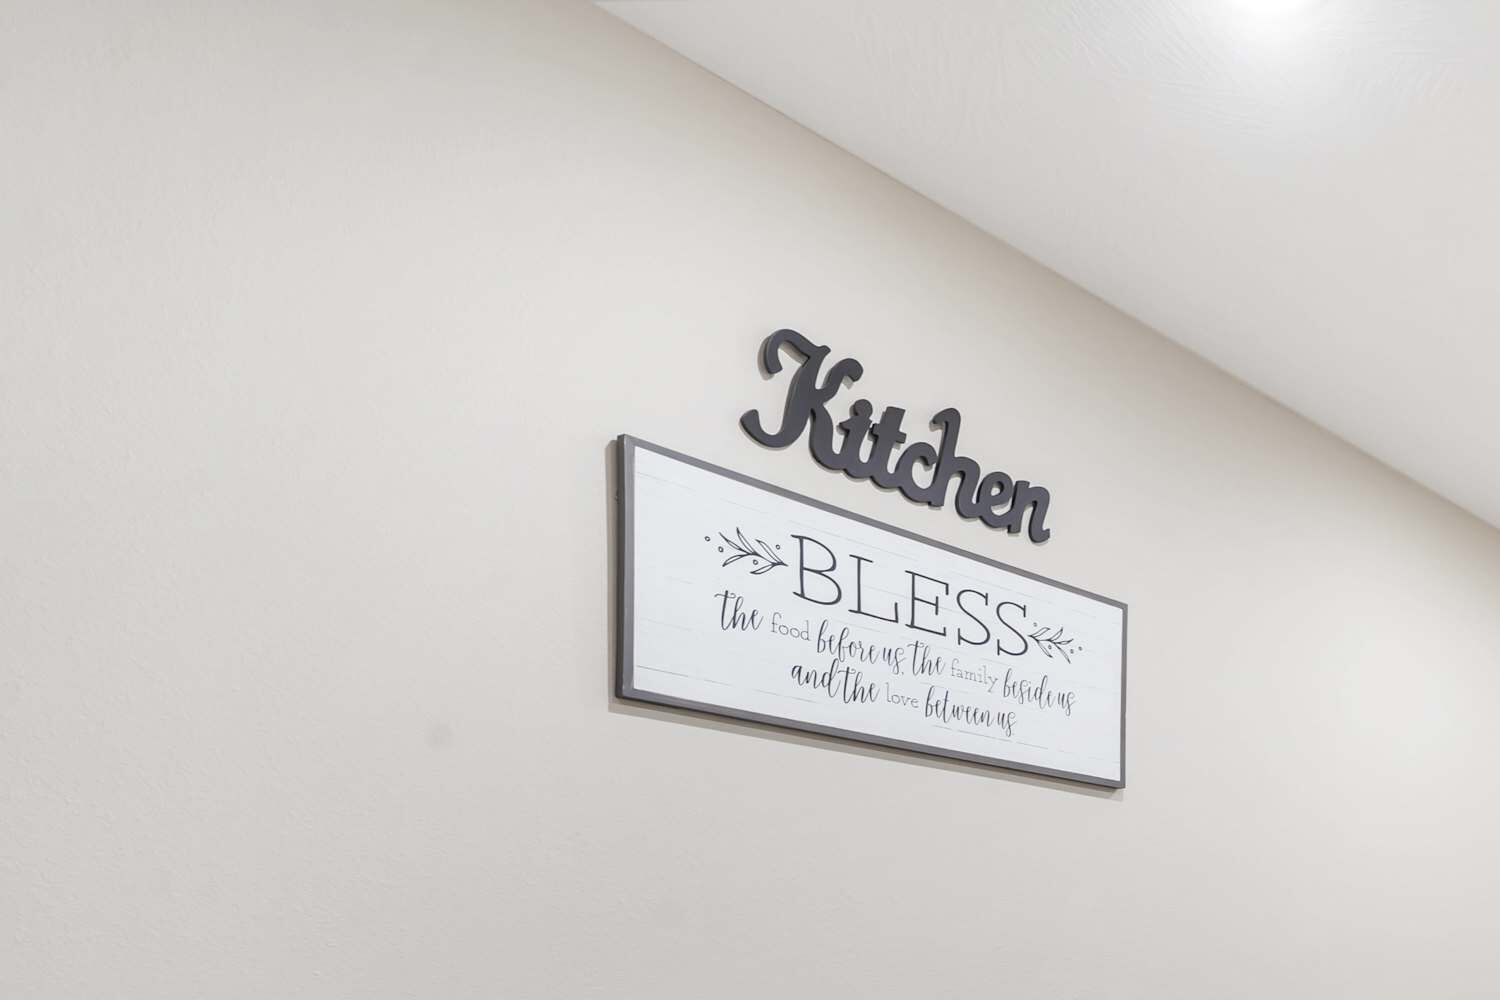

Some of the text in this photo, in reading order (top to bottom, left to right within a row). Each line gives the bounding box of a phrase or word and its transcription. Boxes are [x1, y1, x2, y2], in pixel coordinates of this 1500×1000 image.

[740, 329, 1050, 544] Kitchen
[714, 590, 764, 631] the
[771, 612, 811, 642] food
[816, 619, 881, 662] before
[907, 640, 945, 676] the
[951, 658, 998, 693] family
[1003, 668, 1057, 710] beside
[791, 534, 1029, 656] BLESS
[791, 658, 840, 698] and
[838, 666, 881, 704] the
[886, 682, 919, 709] love
[925, 685, 994, 728] between
